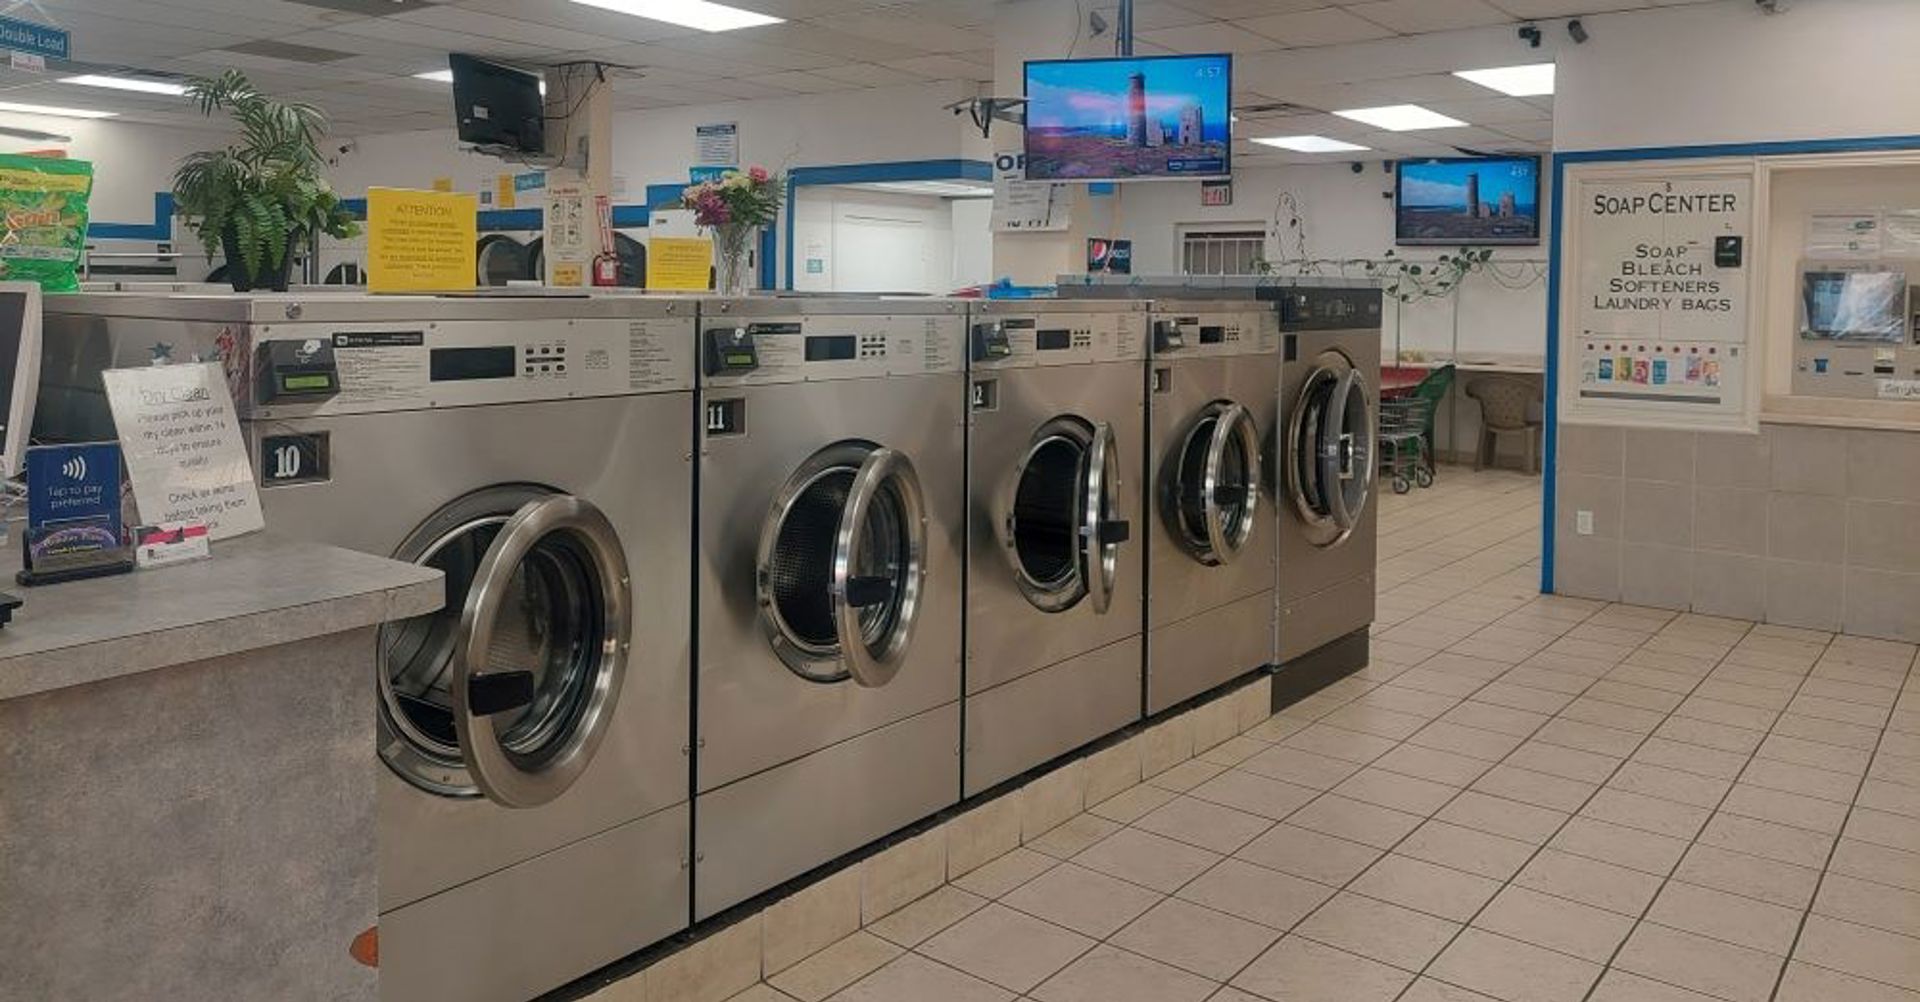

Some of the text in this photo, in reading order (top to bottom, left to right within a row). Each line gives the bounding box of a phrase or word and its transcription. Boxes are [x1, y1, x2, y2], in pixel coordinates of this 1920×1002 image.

[38, 33, 64, 52] Load
[1593, 193, 1737, 215] SOAP CENTER
[1634, 243, 1689, 259] SOAP
[1621, 260, 1702, 276] BLEACH
[1609, 278, 1720, 293] SOFTENERS
[1594, 295, 1731, 312] LAUNDRY BAGS
[707, 405, 725, 430] 11
[273, 445, 301, 478] 10
[49, 484, 103, 498] Tap to pay
